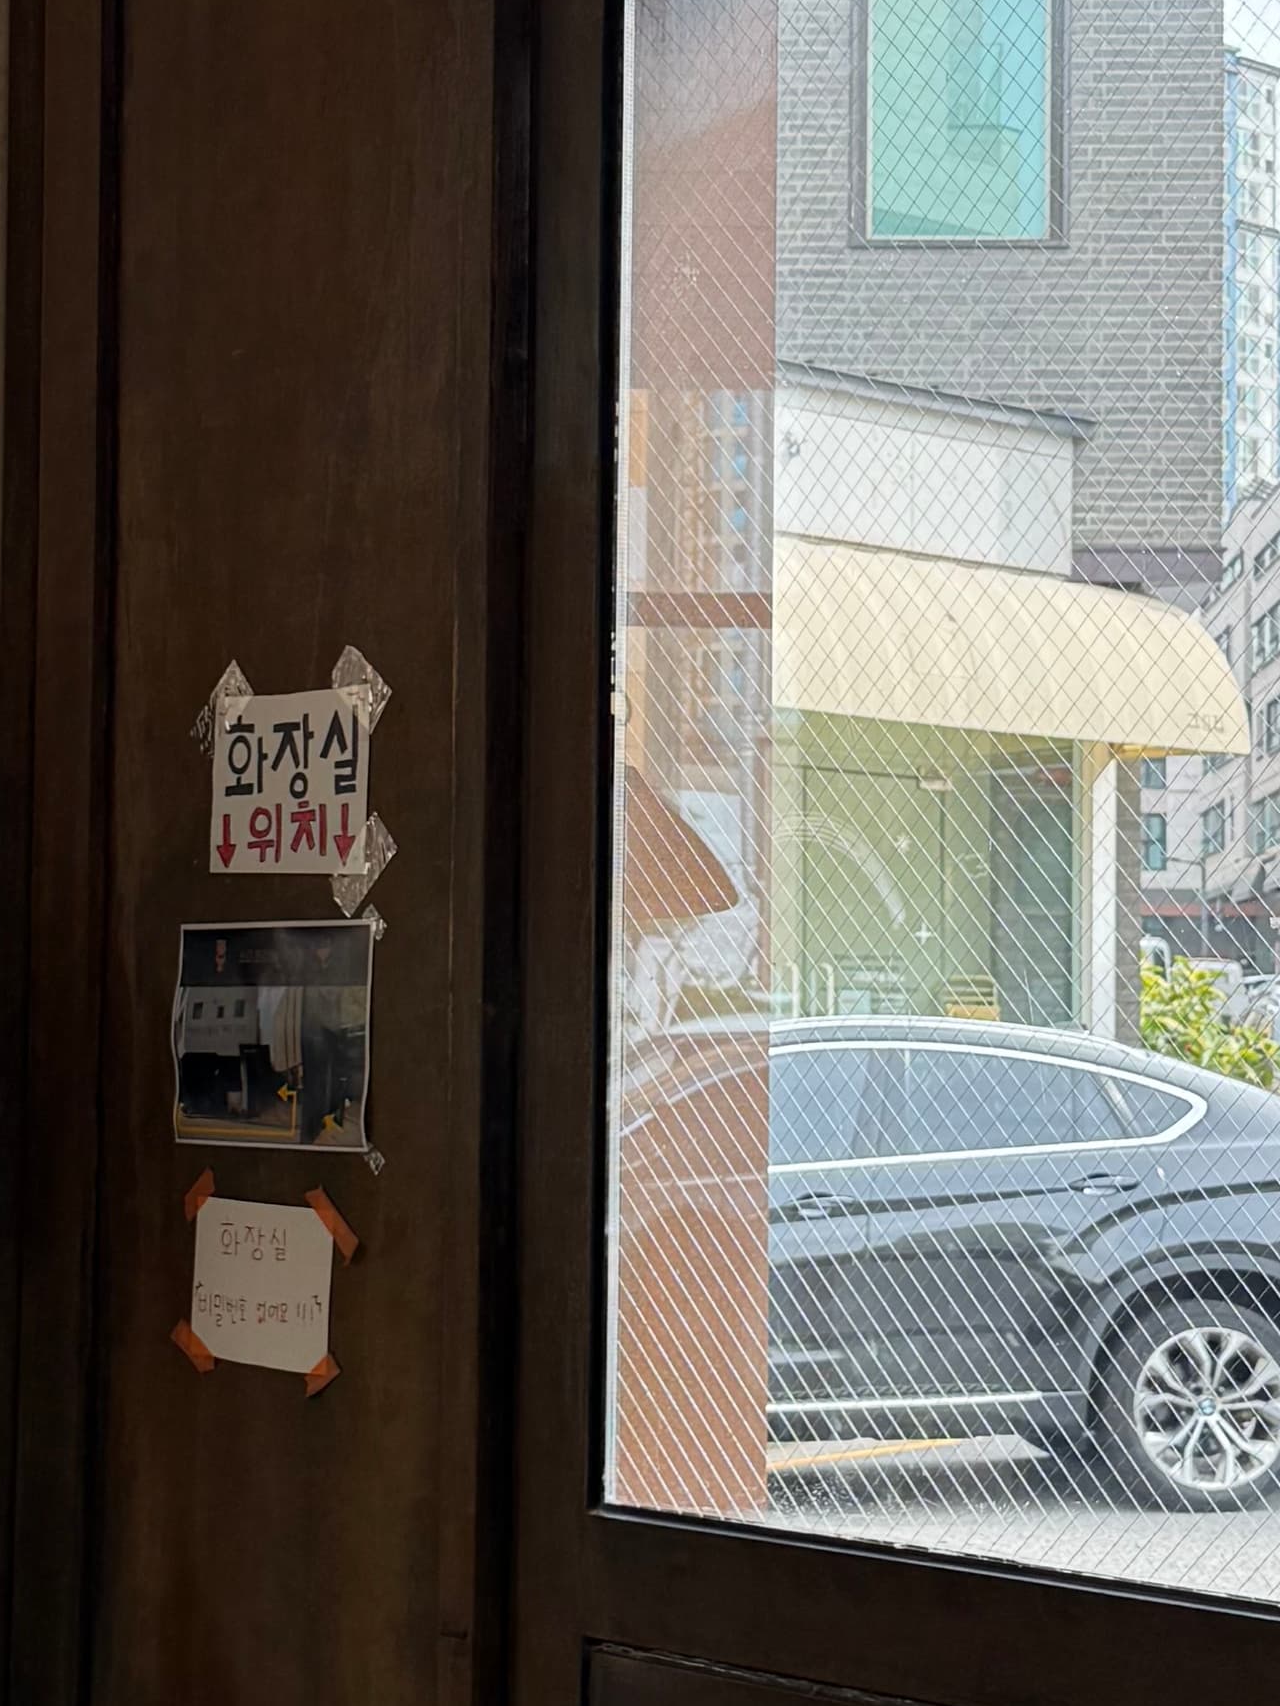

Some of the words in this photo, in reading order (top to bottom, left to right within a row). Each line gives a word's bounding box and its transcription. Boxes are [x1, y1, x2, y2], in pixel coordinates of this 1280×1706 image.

[224, 704, 359, 799] 화장실
[247, 799, 327, 863] 위치
[220, 1218, 288, 1261] 화장실
